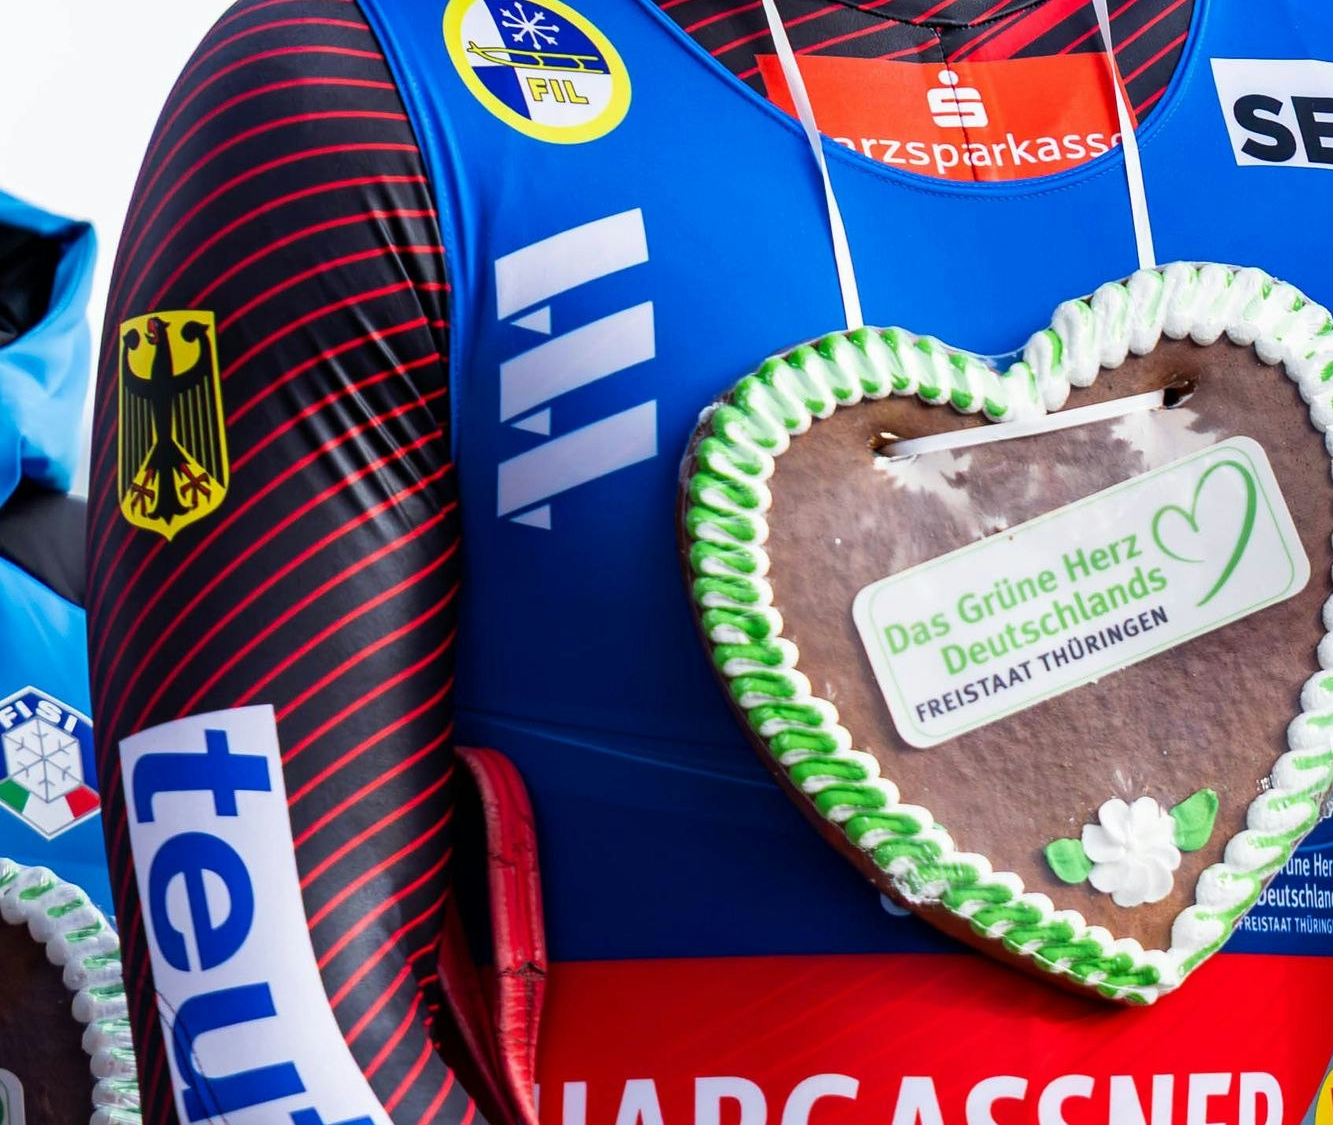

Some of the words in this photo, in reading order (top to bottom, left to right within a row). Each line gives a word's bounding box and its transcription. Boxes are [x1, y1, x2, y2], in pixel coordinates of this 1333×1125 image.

[526, 77, 589, 104] FIL
[884, 611, 952, 656] Das
[956, 570, 1058, 624] Grüne
[1062, 534, 1143, 583] Herz
[940, 566, 1168, 675] Deutschlands
[0, 700, 79, 733] FISI
[916, 661, 1034, 723] FREISTAAT
[1037, 605, 1169, 673] THÜRINGEN
[133, 729, 376, 1125] teu
